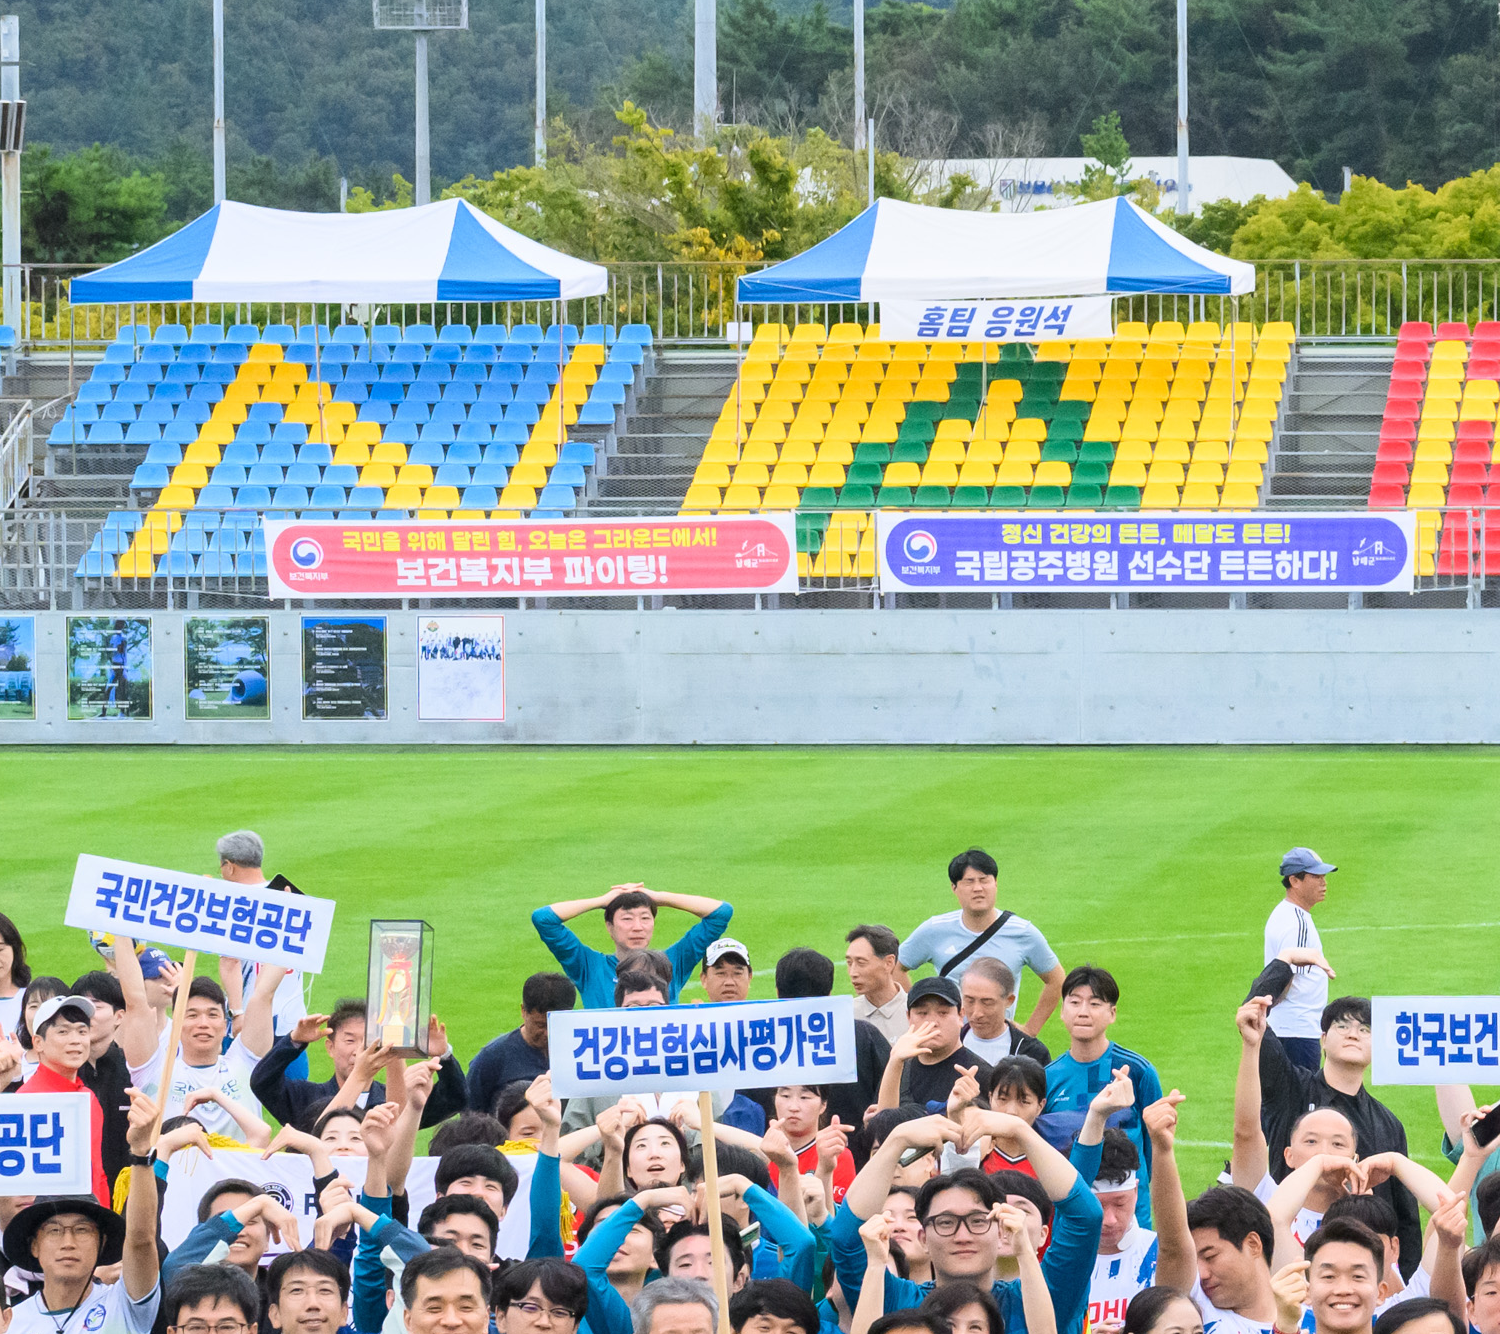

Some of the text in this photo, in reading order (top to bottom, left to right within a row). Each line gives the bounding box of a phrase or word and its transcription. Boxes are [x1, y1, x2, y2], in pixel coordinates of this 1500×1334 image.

[918, 305, 1072, 338] 홈팀 응원석
[343, 528, 717, 552] 국민을 위해 달린 힘, 오늘은 그라운드에서!
[1002, 524, 1291, 545] 정신 건강의 든든, 메달도 든든!
[396, 554, 668, 587] 보건복지부 파이팅!
[955, 550, 1338, 582] 국립공주병원 선수단 든든하다!
[94, 871, 313, 956] 국민건강보험공단
[573, 1011, 838, 1081] 건강보험심사평가원
